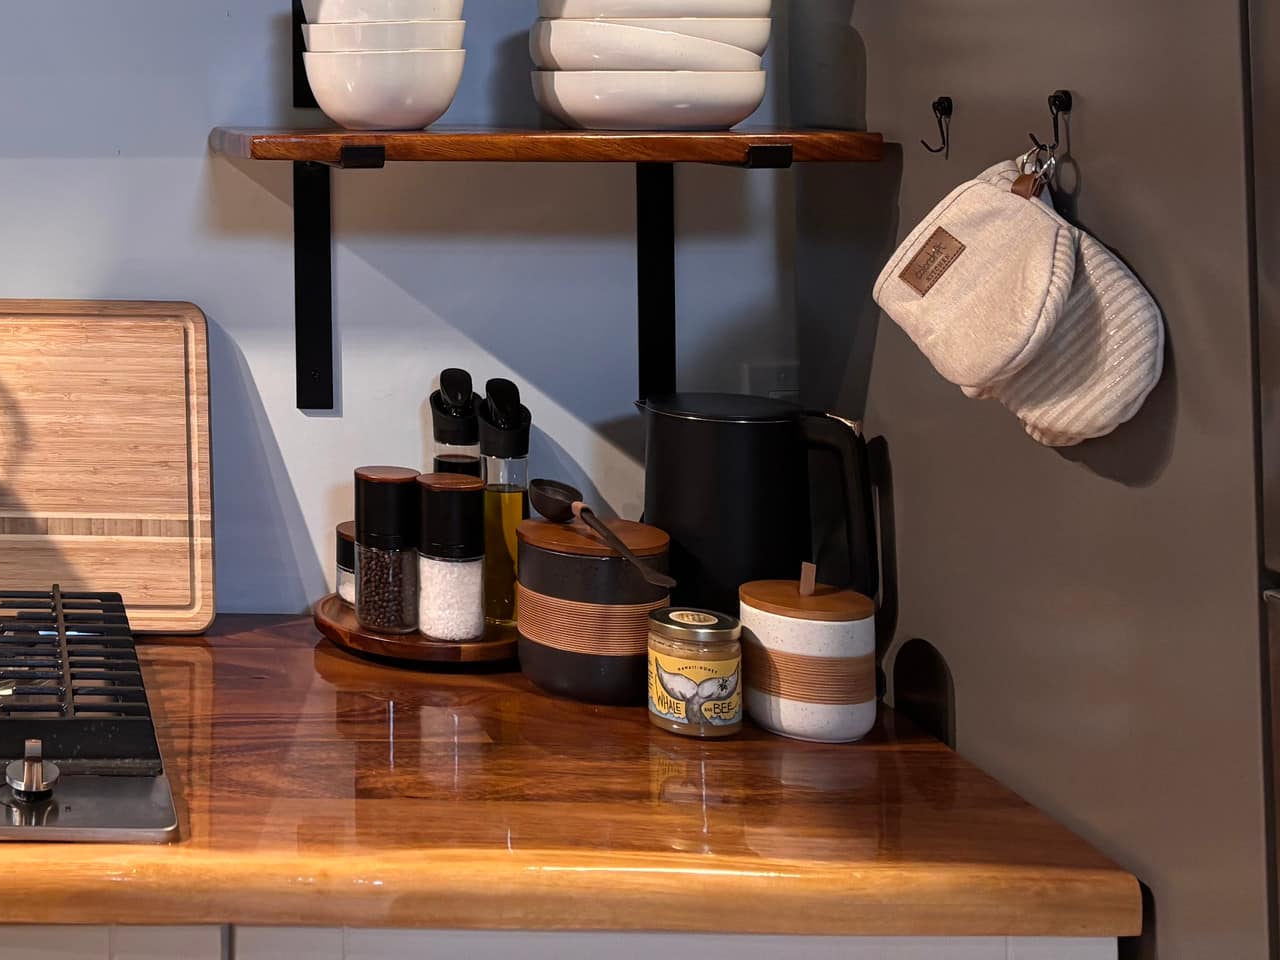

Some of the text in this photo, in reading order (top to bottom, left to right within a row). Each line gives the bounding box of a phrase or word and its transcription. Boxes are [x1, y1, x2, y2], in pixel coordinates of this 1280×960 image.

[926, 255, 951, 281] KITCHEN
[656, 686, 682, 715] WHALE
[713, 701, 736, 715] BEE
